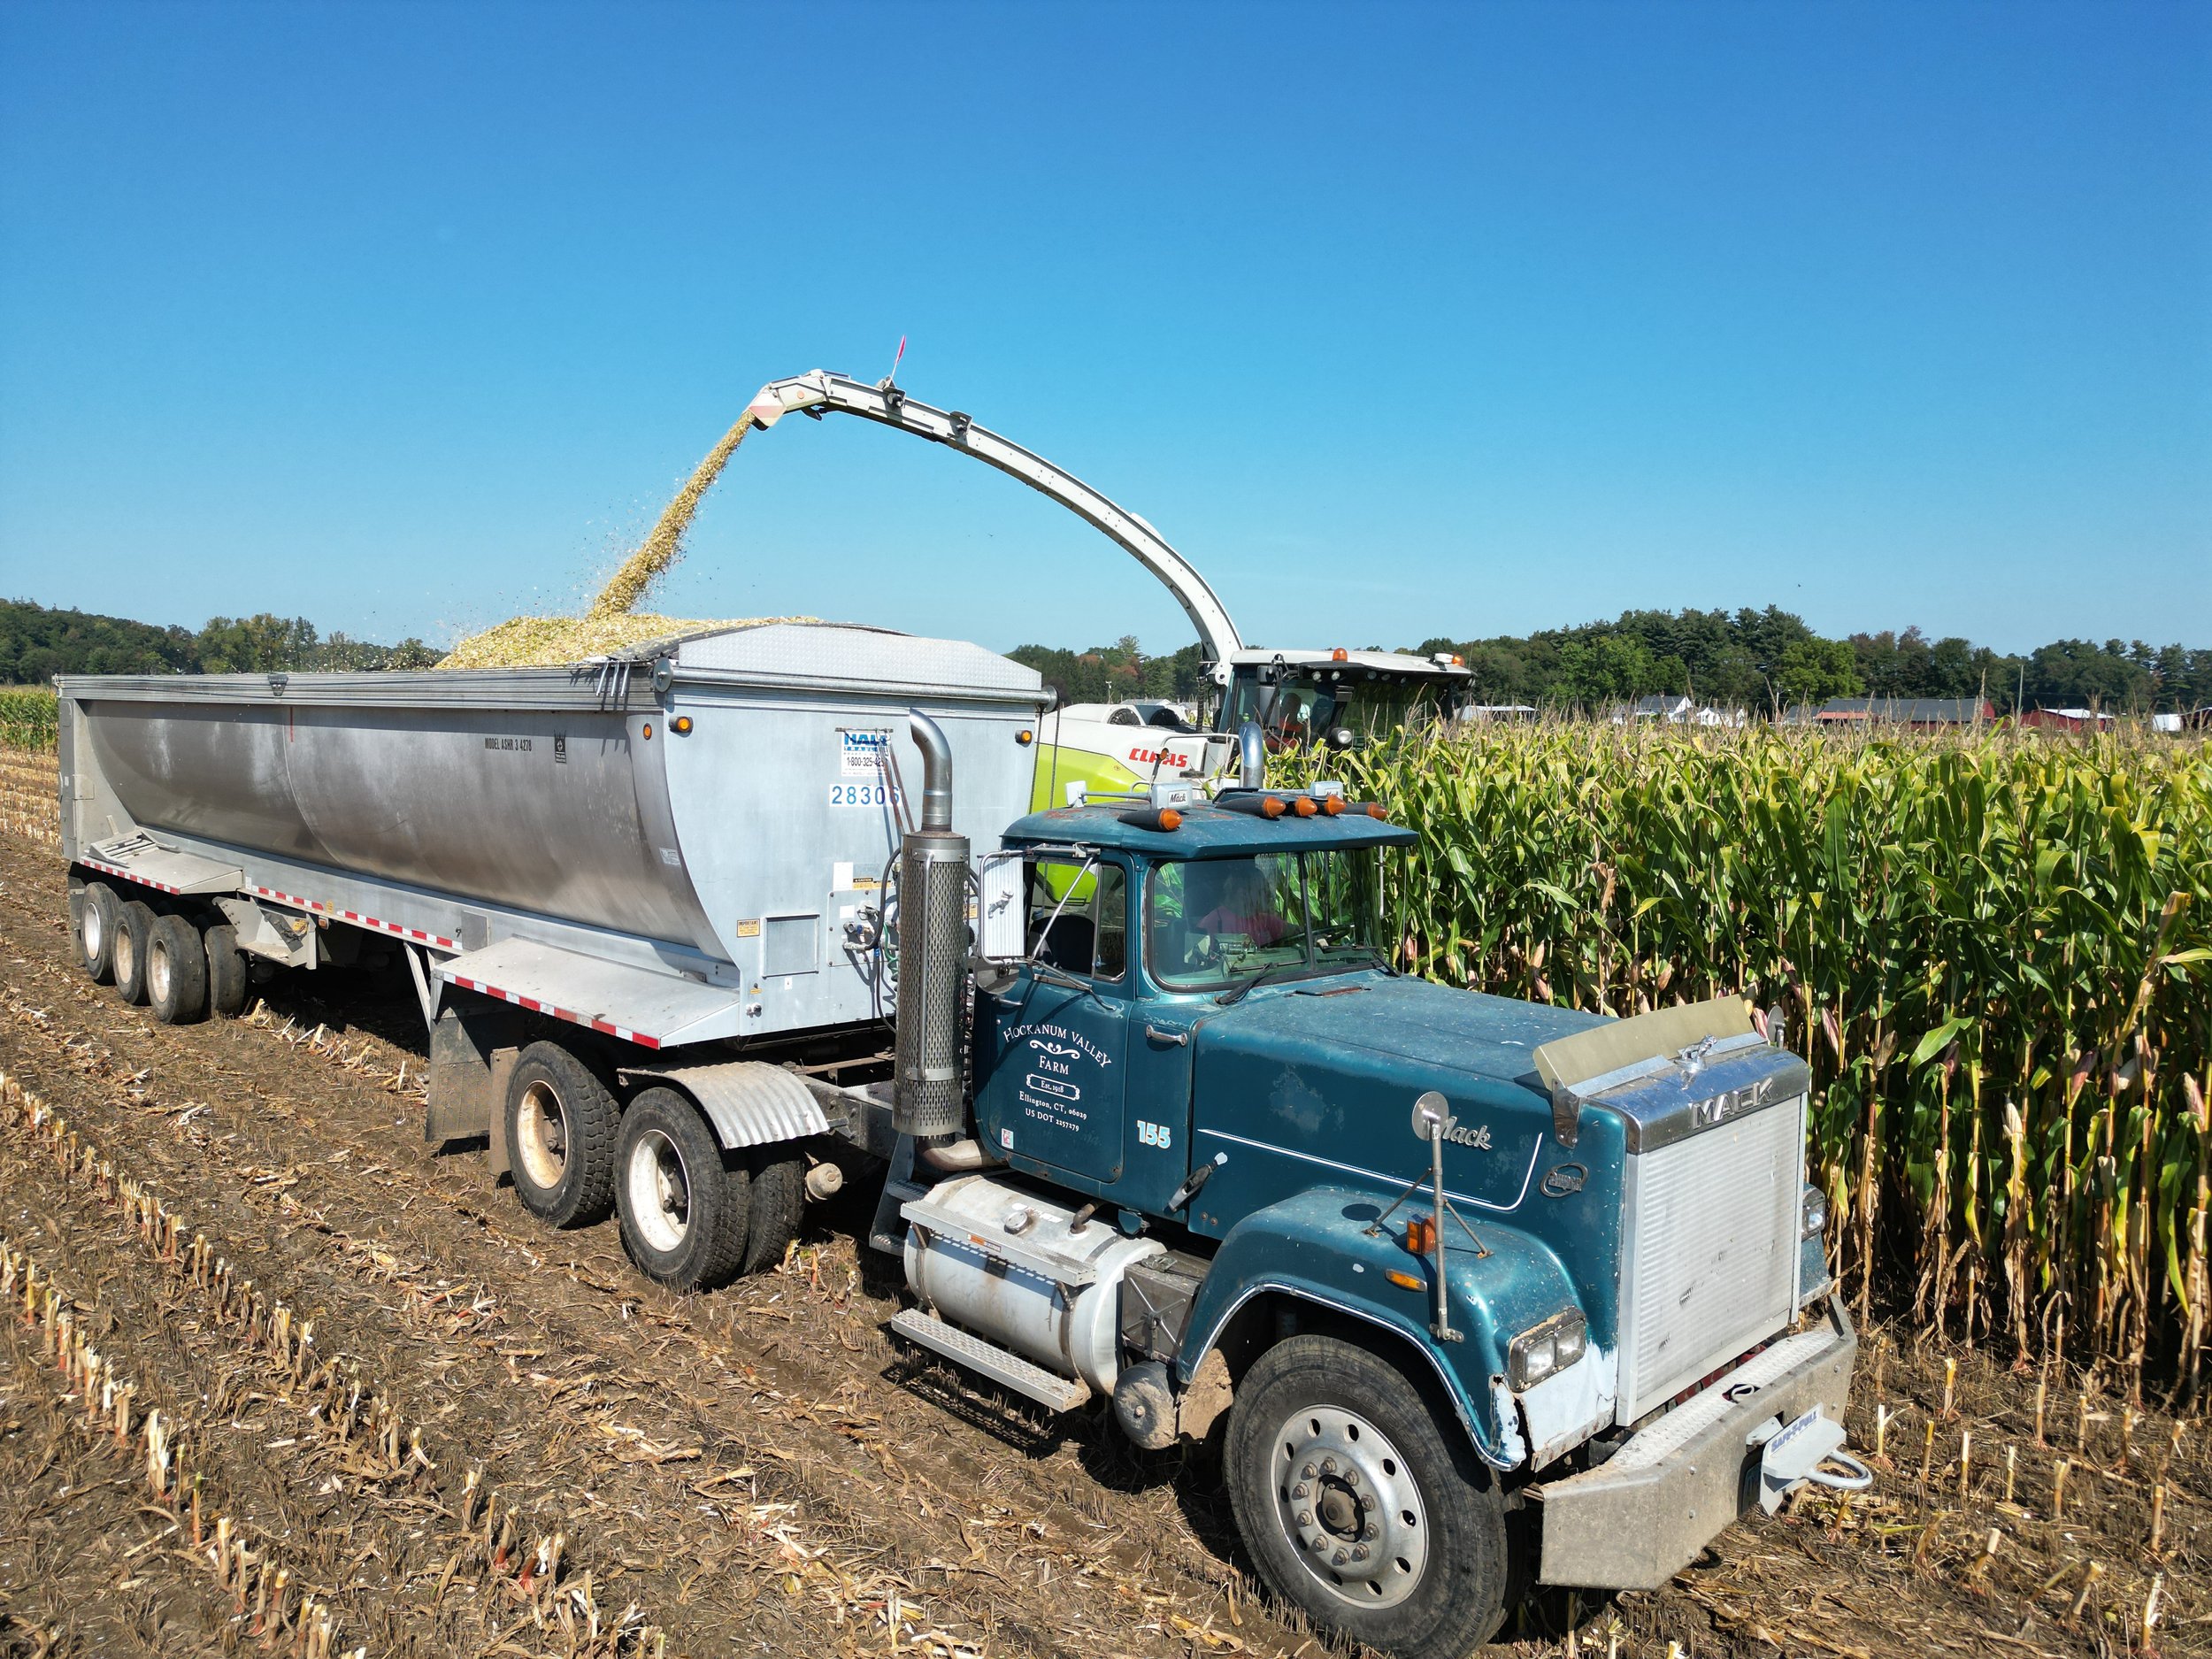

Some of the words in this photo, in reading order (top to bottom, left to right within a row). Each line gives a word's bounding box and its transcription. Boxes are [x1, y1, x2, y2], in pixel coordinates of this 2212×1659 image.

[484, 737, 500, 750] MODEL
[515, 739, 518, 751] 3
[832, 785, 900, 805] 28306
[1169, 793, 1187, 803] Mack
[1002, 1024, 1067, 1043] HOCKANUM
[1071, 1031, 1111, 1068] VALLEY
[1039, 1055, 1069, 1075] FARM
[1041, 1079, 1051, 1090] Est.
[1052, 1085, 1064, 1094] 1918
[1019, 1090, 1052, 1110] Ellington,
[1054, 1102, 1067, 1115] CT,
[1068, 1108, 1087, 1120] 06029
[1693, 1077, 1773, 1130] MACK
[1025, 1108, 1035, 1118] US
[1037, 1111, 1055, 1123] DOT
[1056, 1118, 1079, 1133] 2257279
[1136, 1119, 1171, 1149] 155
